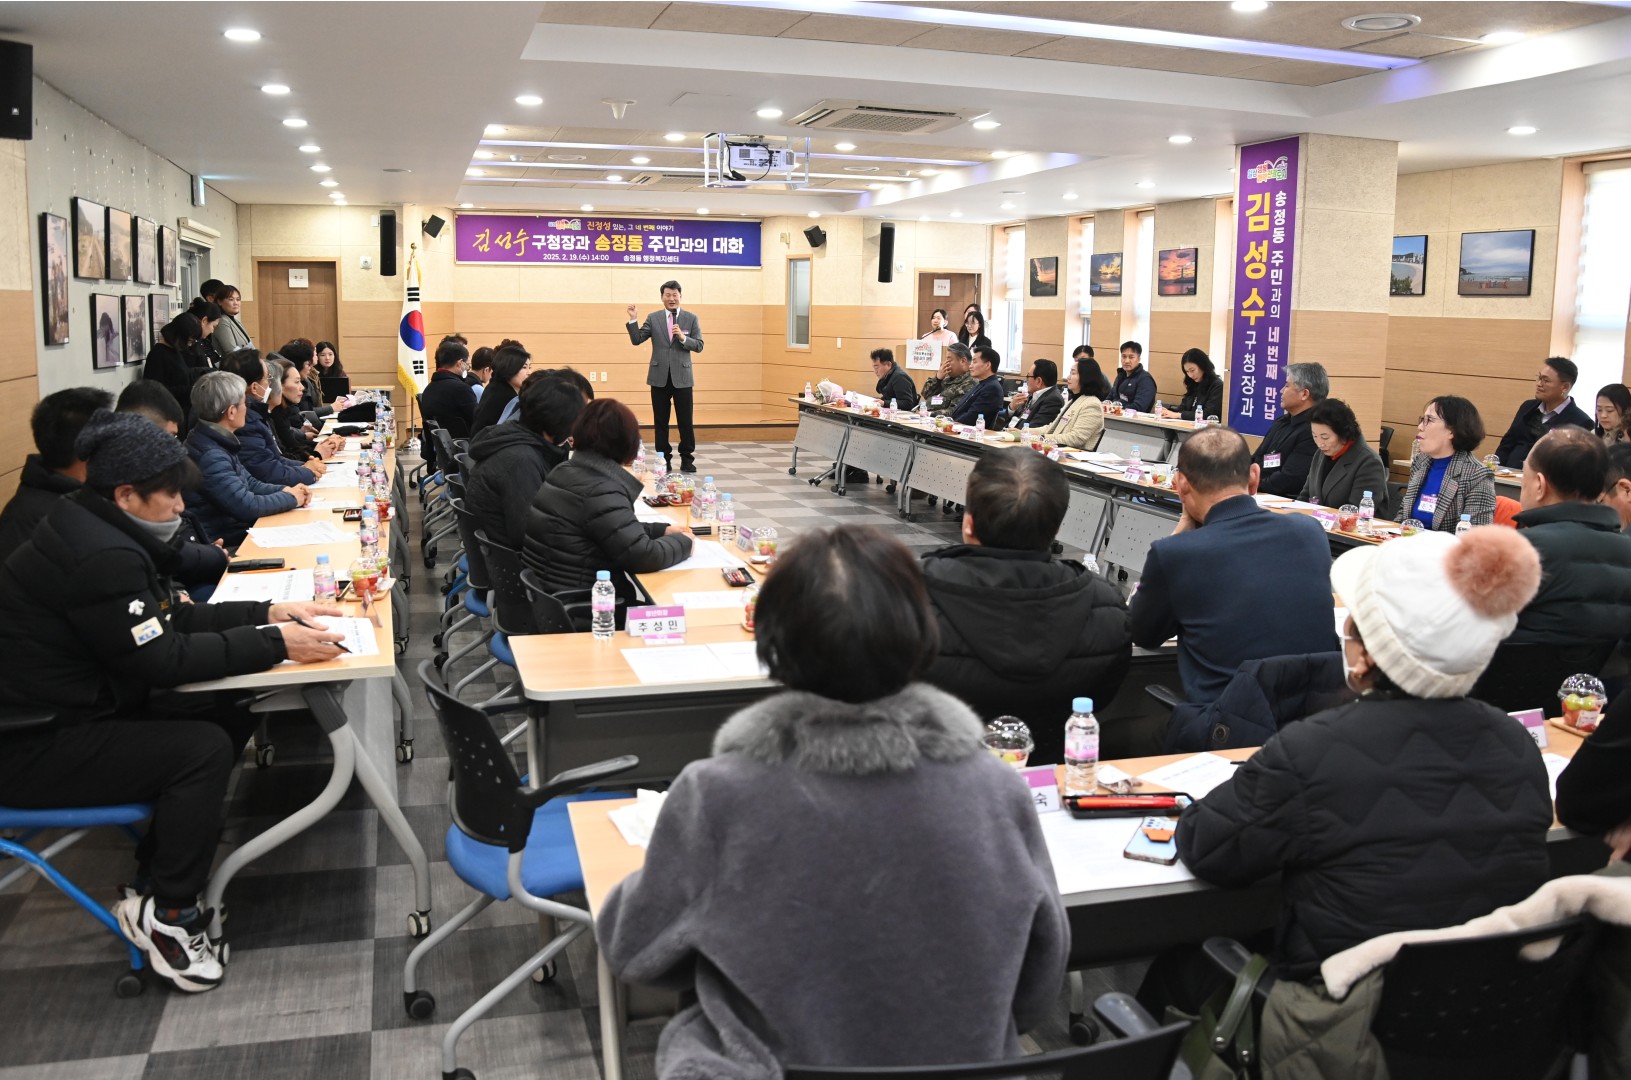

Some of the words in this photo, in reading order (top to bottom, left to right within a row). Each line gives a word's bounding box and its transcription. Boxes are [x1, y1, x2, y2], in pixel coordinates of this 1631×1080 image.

[586, 221, 611, 231] 진정성
[1272, 190, 1287, 244] 송정동
[531, 234, 590, 251] 구청장과
[594, 233, 644, 252] 송정동
[647, 235, 708, 253] 주민과의
[712, 236, 745, 255] 대화
[643, 255, 680, 263] 행정복지센터
[1241, 192, 1271, 326] 김성수
[1270, 250, 1284, 319] 주민과의
[1240, 330, 1257, 418] 구청장과
[1264, 386, 1278, 421] 만남
